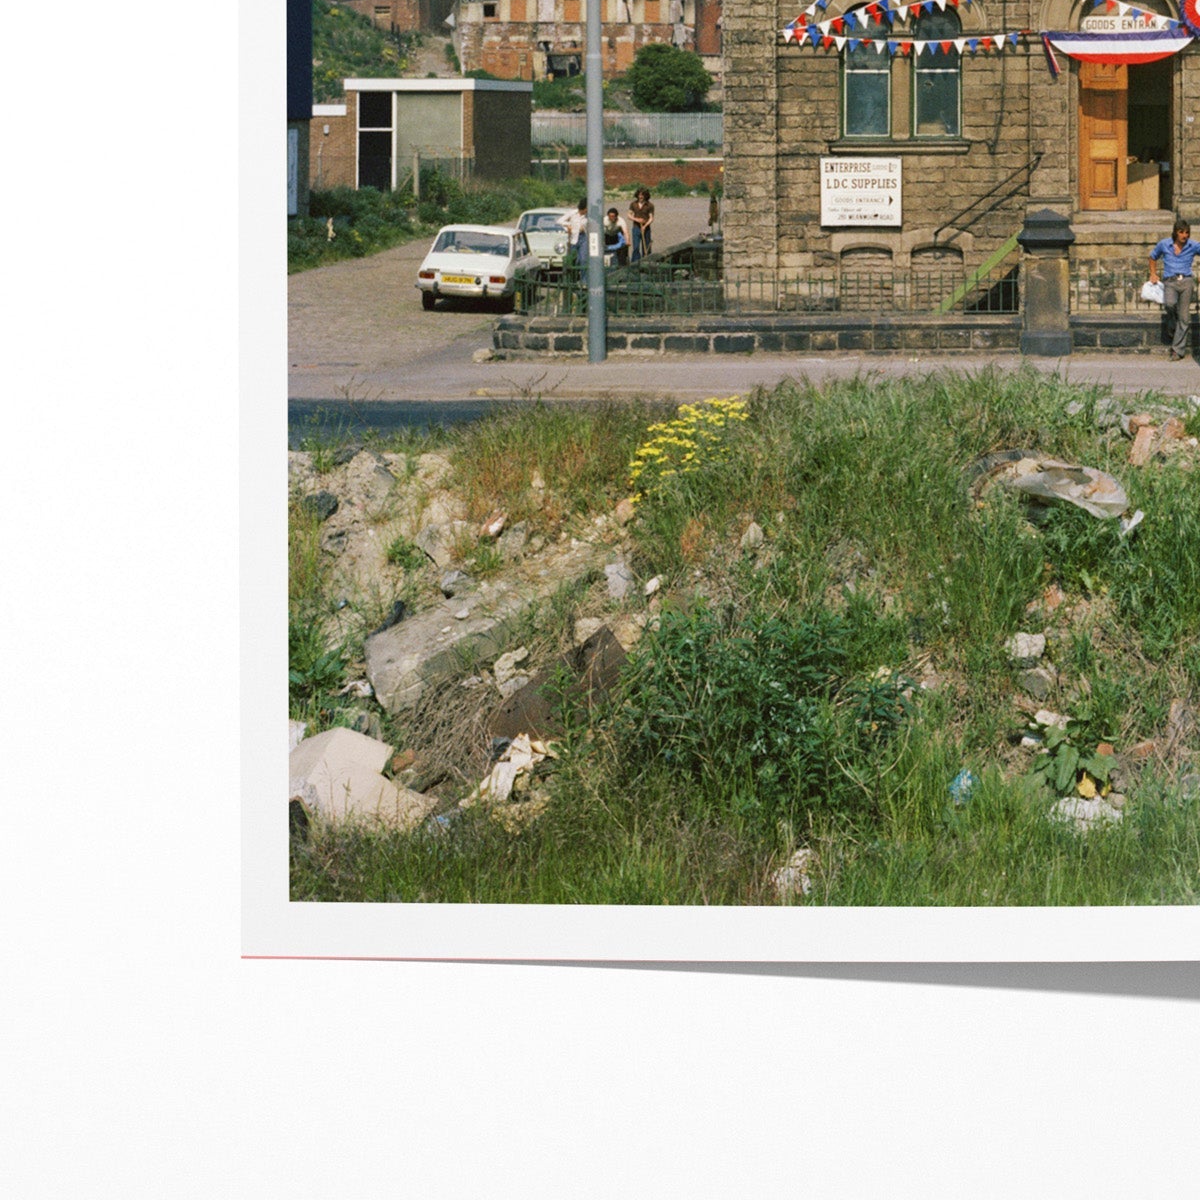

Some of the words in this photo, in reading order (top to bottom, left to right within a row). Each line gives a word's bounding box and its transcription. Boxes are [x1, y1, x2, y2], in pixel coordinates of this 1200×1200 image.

[1085, 19, 1116, 30] GOODS
[824, 162, 872, 173] ENTERPRISE
[851, 178, 898, 189] SUPPLIES
